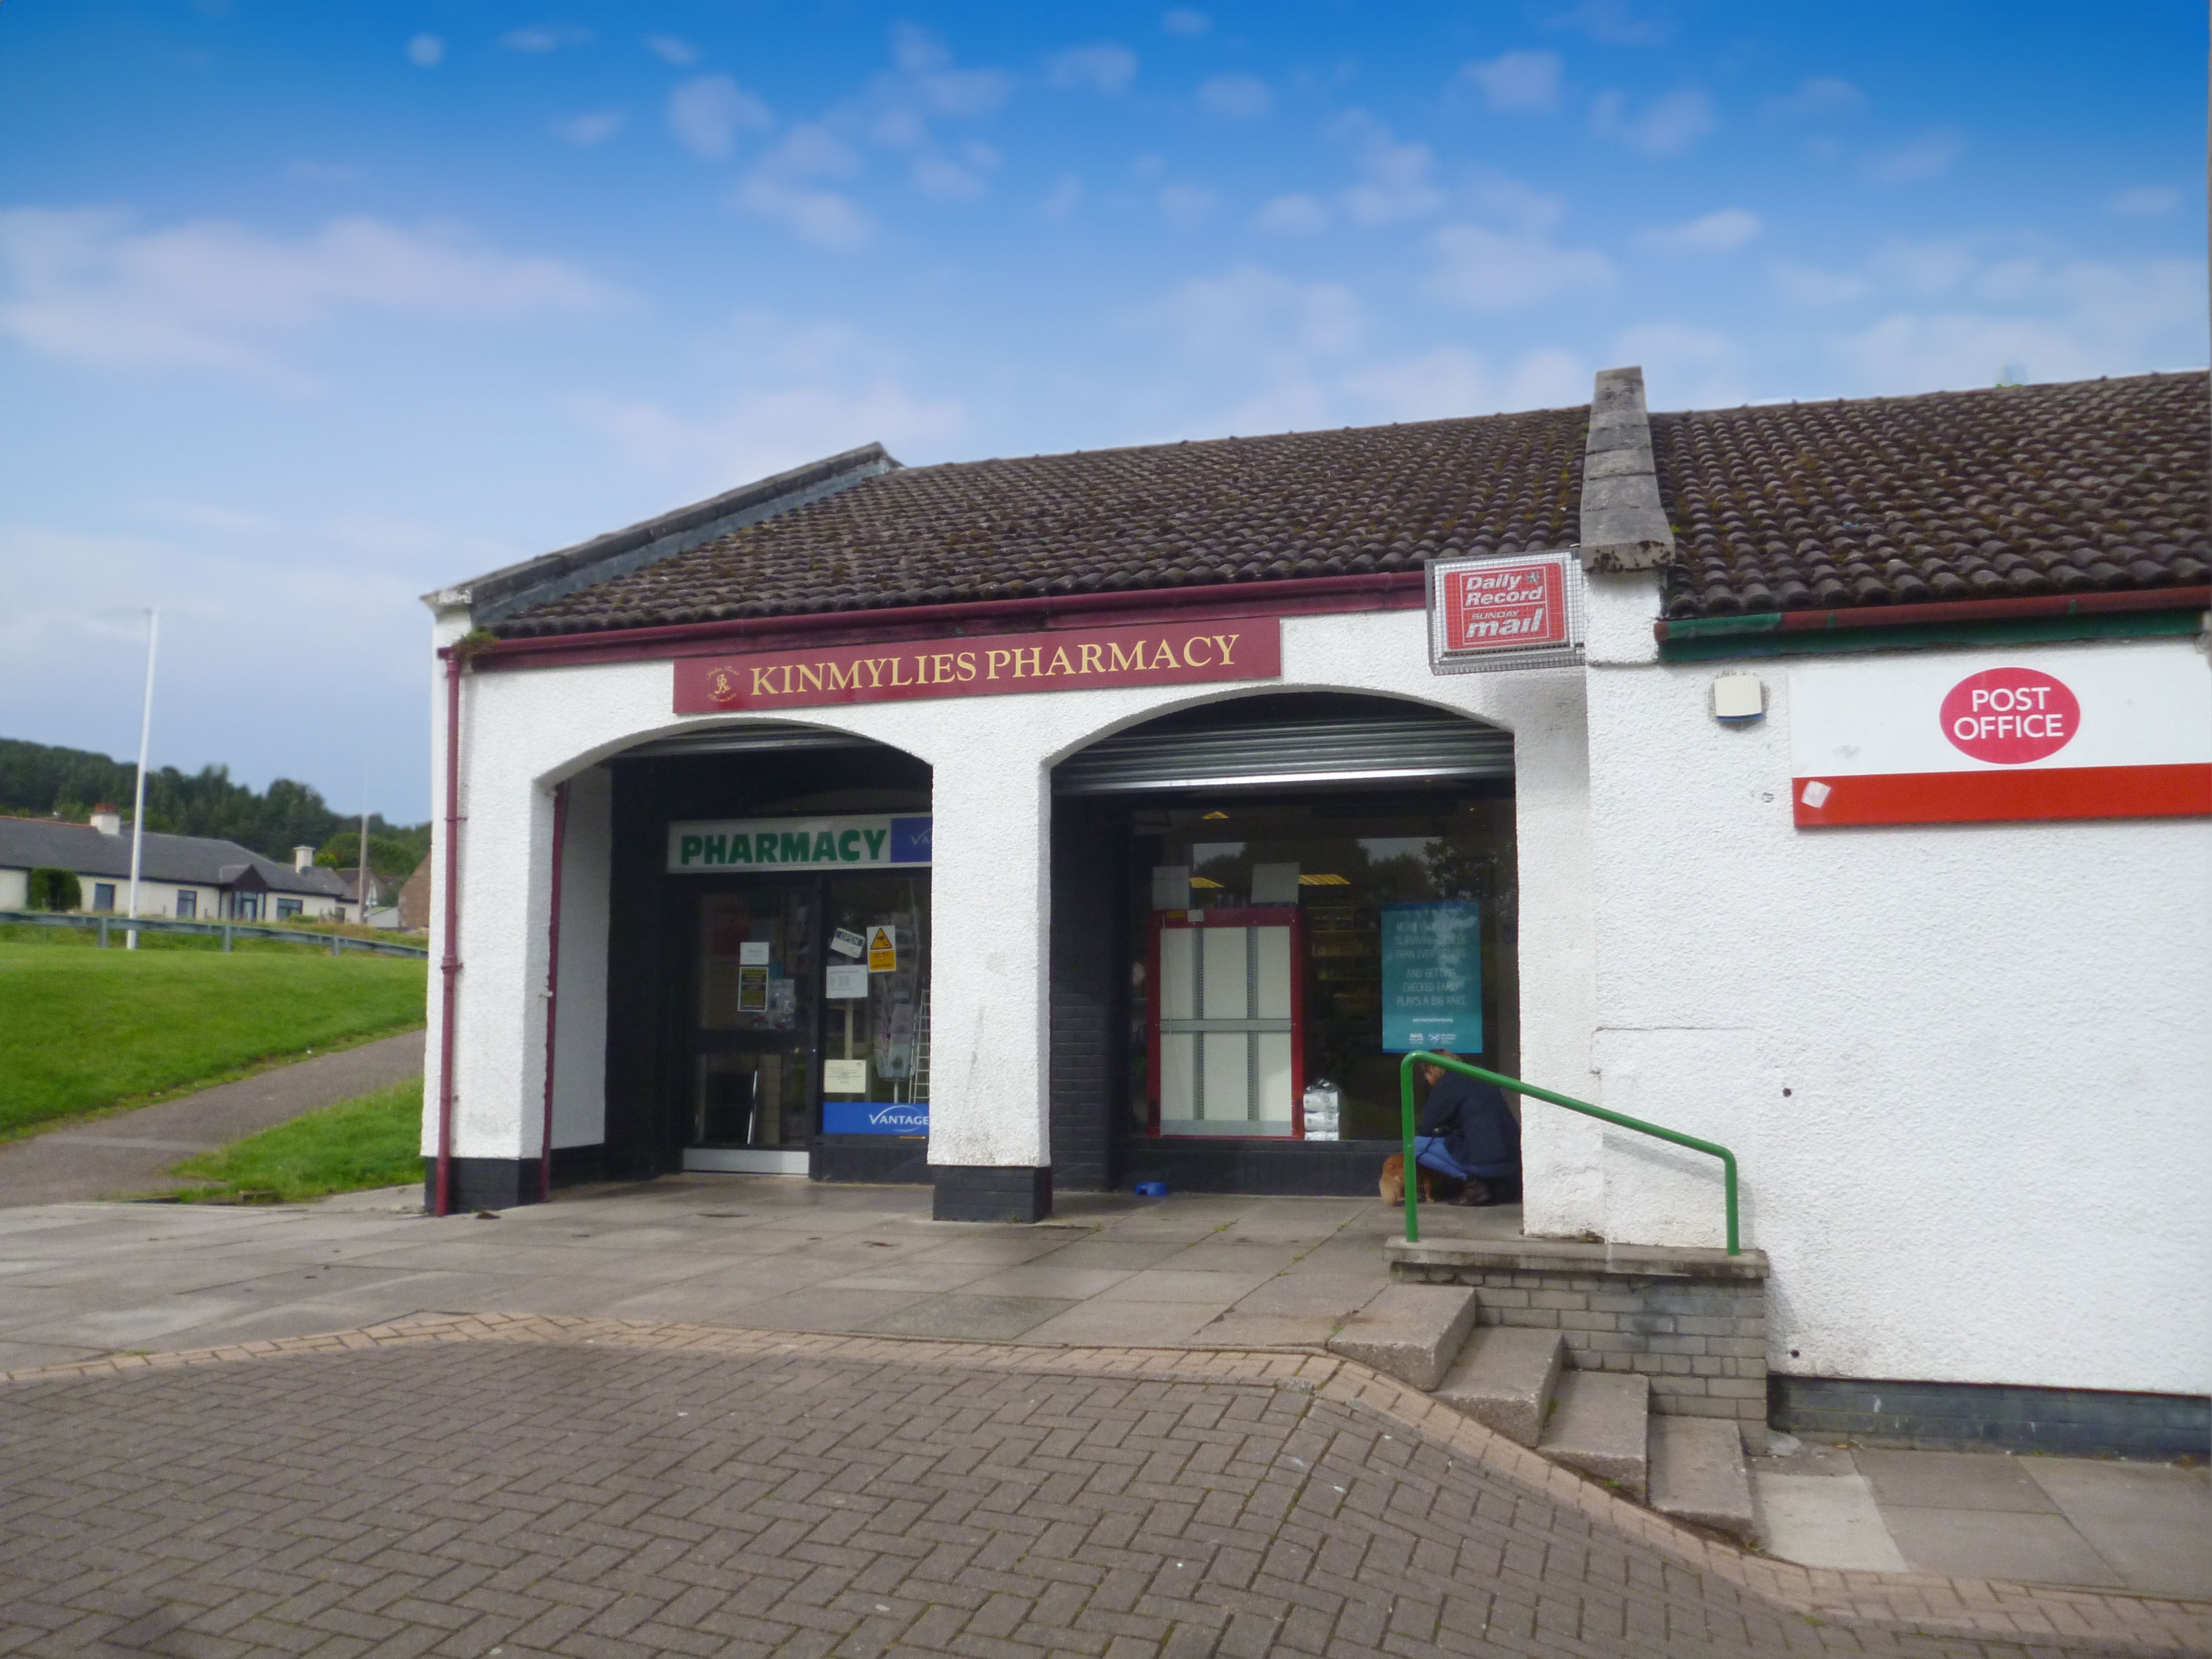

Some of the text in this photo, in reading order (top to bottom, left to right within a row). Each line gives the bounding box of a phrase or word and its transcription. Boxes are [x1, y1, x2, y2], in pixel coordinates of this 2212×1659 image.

[1465, 573, 1521, 590] Daily
[1465, 586, 1543, 606] Record
[1472, 609, 1520, 620] SUNDAY
[1466, 608, 1544, 639] mail
[750, 634, 1240, 696] KINMYLIES PHARMACY
[1972, 687, 2051, 712] POST
[1953, 714, 2064, 740] OFFICE
[681, 829, 886, 865] PHARMACY
[840, 933, 859, 945] OPEN
[1407, 968, 1422, 978] AND
[1402, 982, 1435, 992] CHECKED
[1397, 996, 1421, 1006] PLAYS
[1423, 996, 1430, 1006] A
[1431, 995, 1444, 1006] BIG
[869, 1112, 929, 1125] VANTAGE
